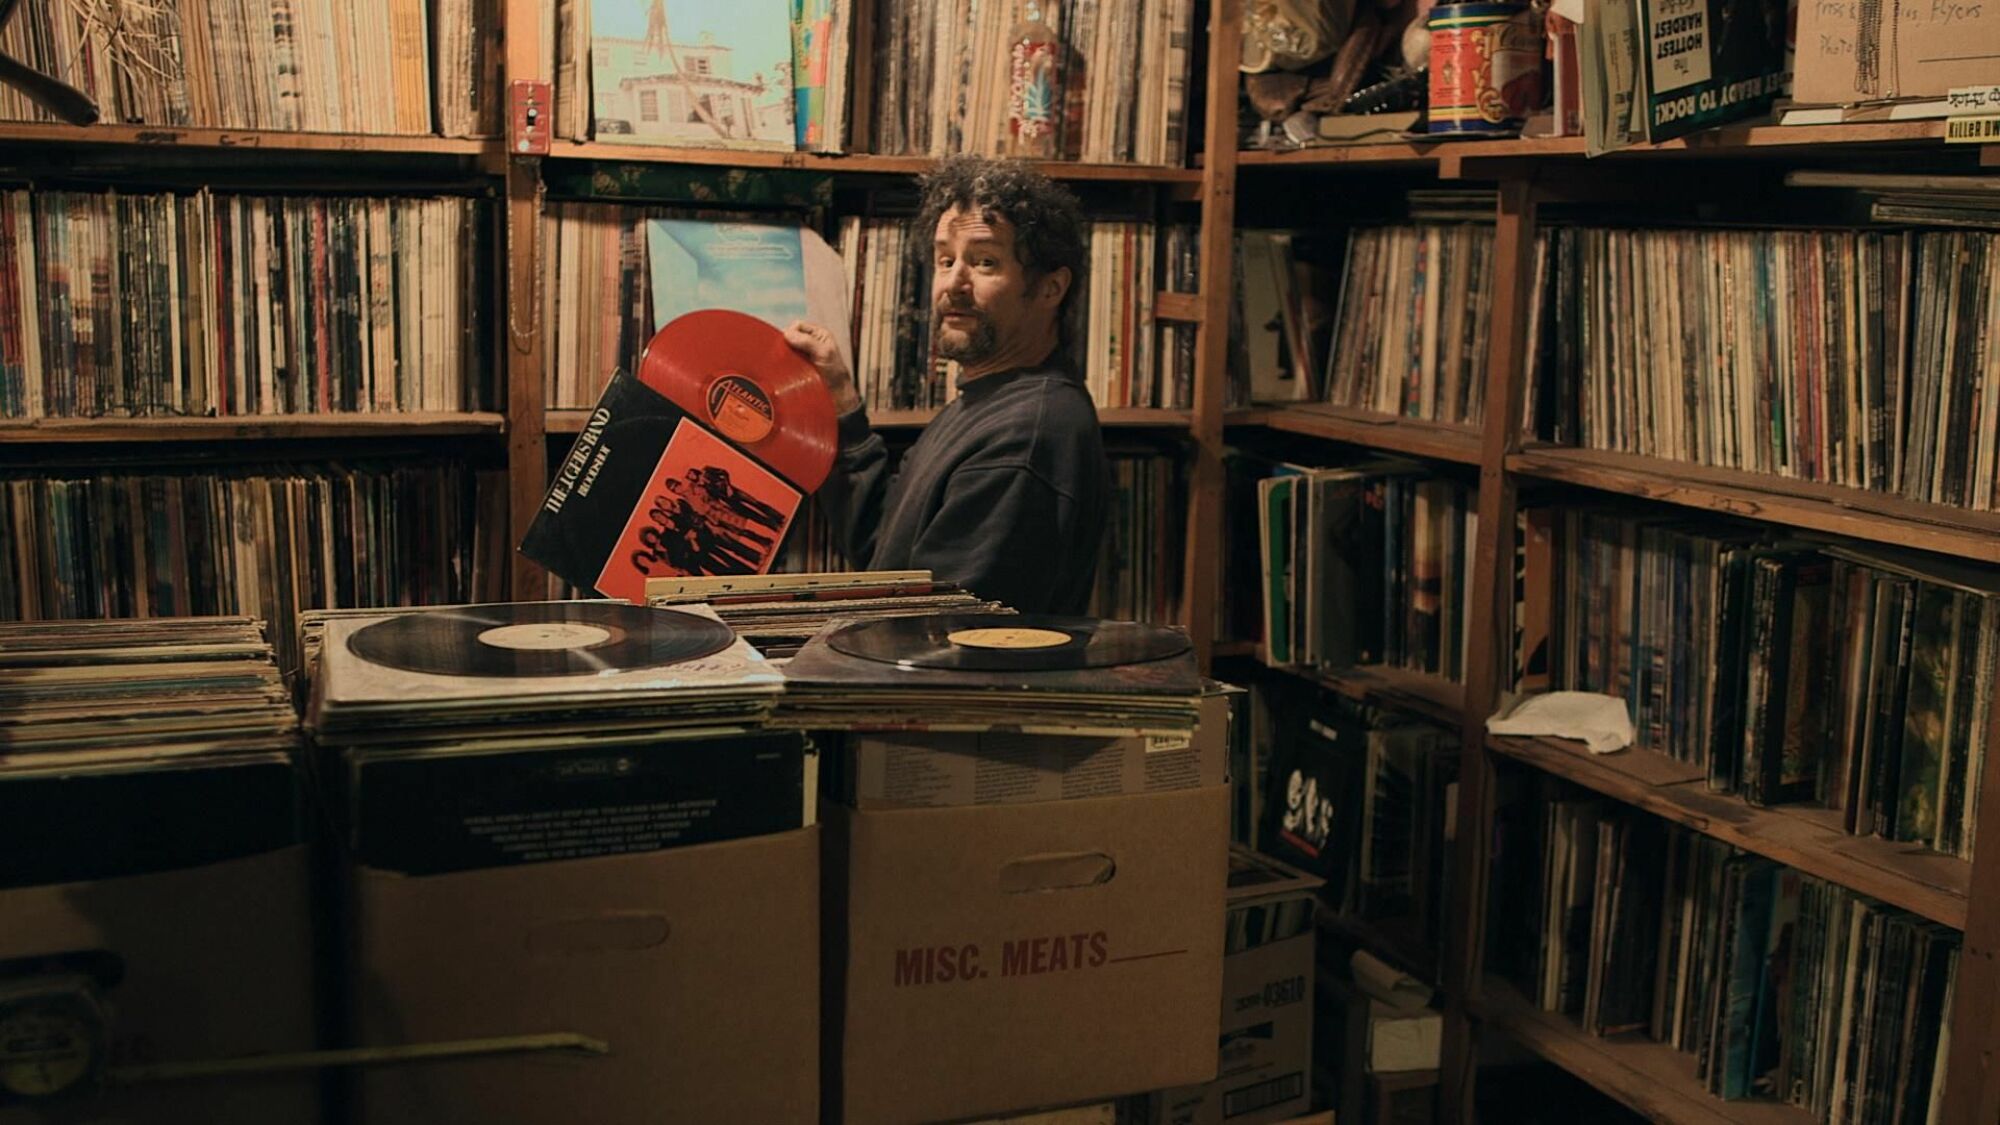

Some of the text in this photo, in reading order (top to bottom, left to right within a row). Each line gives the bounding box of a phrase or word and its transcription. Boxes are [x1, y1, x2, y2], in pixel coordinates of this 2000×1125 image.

[1654, 12, 1703, 39] HARDEST
[1656, 32, 1703, 60] HOTTEST
[1699, 90, 1717, 112] TO
[1719, 77, 1762, 107] READY
[1655, 95, 1696, 126] ROCK!
[544, 484, 570, 514] THE
[582, 407, 613, 446] BAND
[894, 931, 1109, 987] MISC. MEATS
